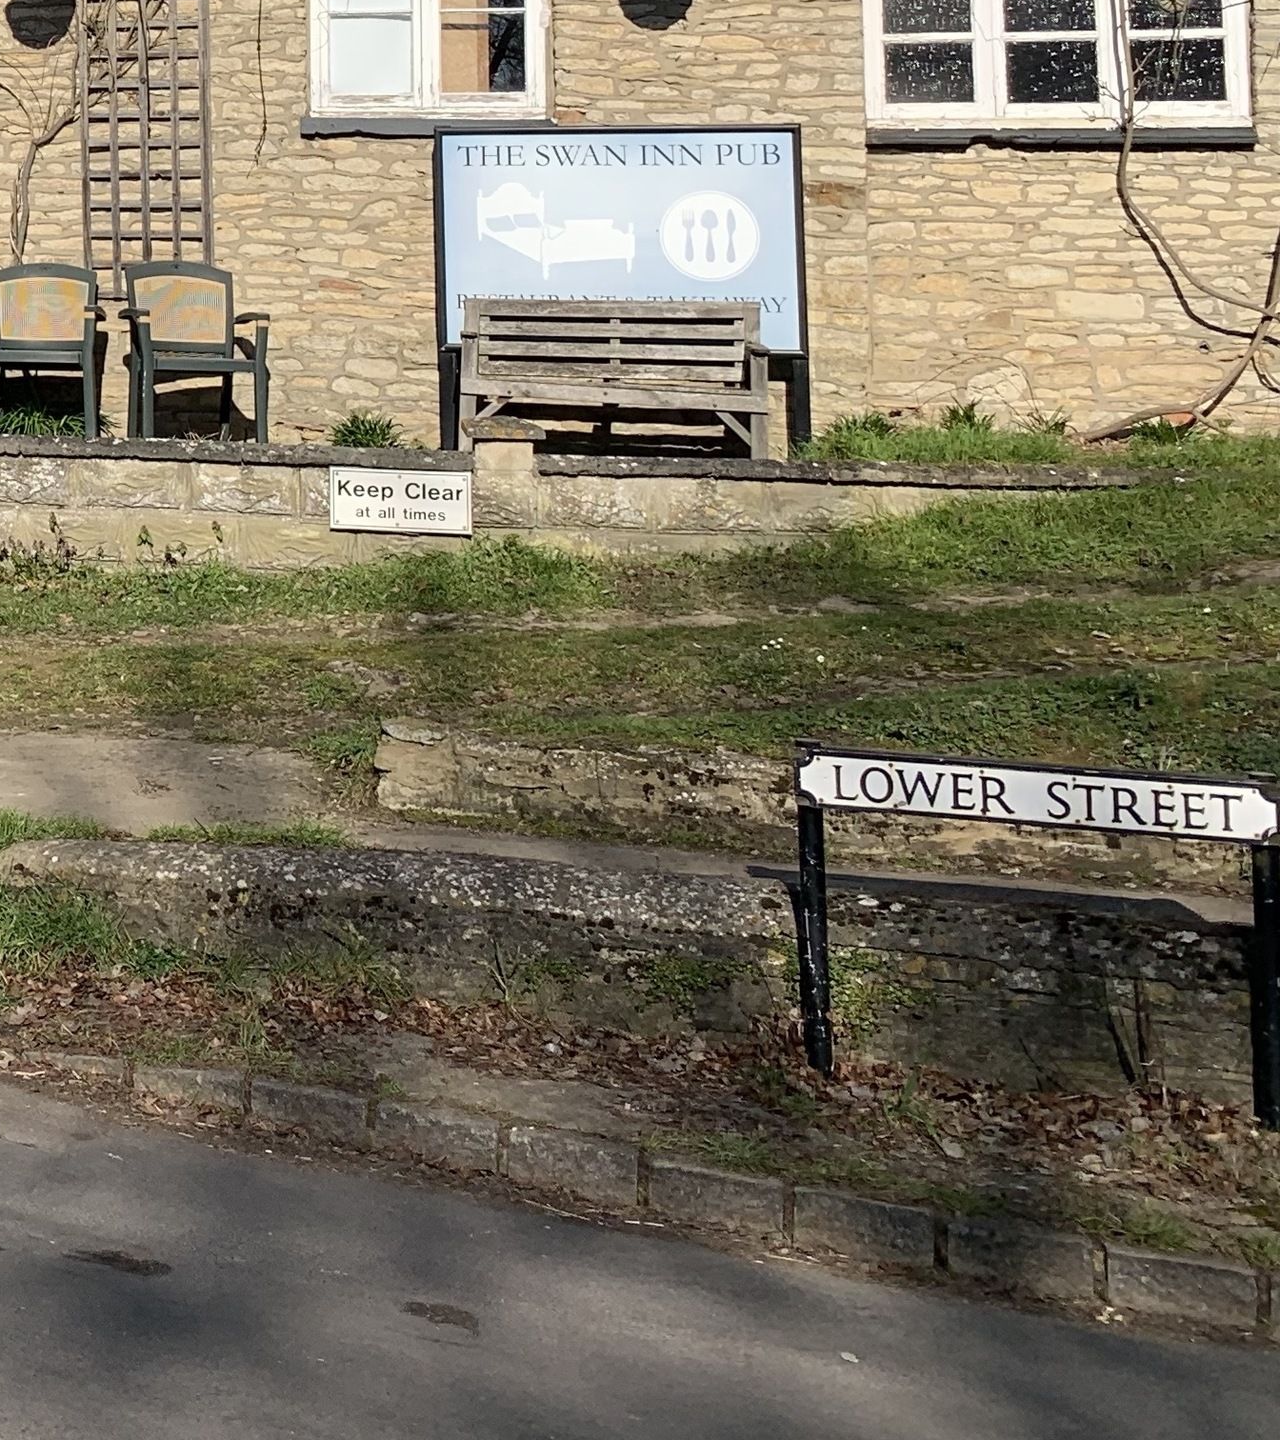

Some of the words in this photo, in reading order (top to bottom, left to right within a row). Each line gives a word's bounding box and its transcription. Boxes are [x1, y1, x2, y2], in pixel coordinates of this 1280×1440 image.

[457, 144, 526, 167] THE
[535, 144, 628, 167] SWAN
[639, 144, 703, 166] INN
[714, 143, 781, 166] PUB
[337, 480, 394, 501] Keep
[405, 482, 463, 501] Clear
[355, 507, 370, 518] at
[378, 507, 395, 519] all
[403, 508, 446, 522] times
[833, 764, 1014, 815] LOWER
[1047, 781, 1243, 832] STREET
